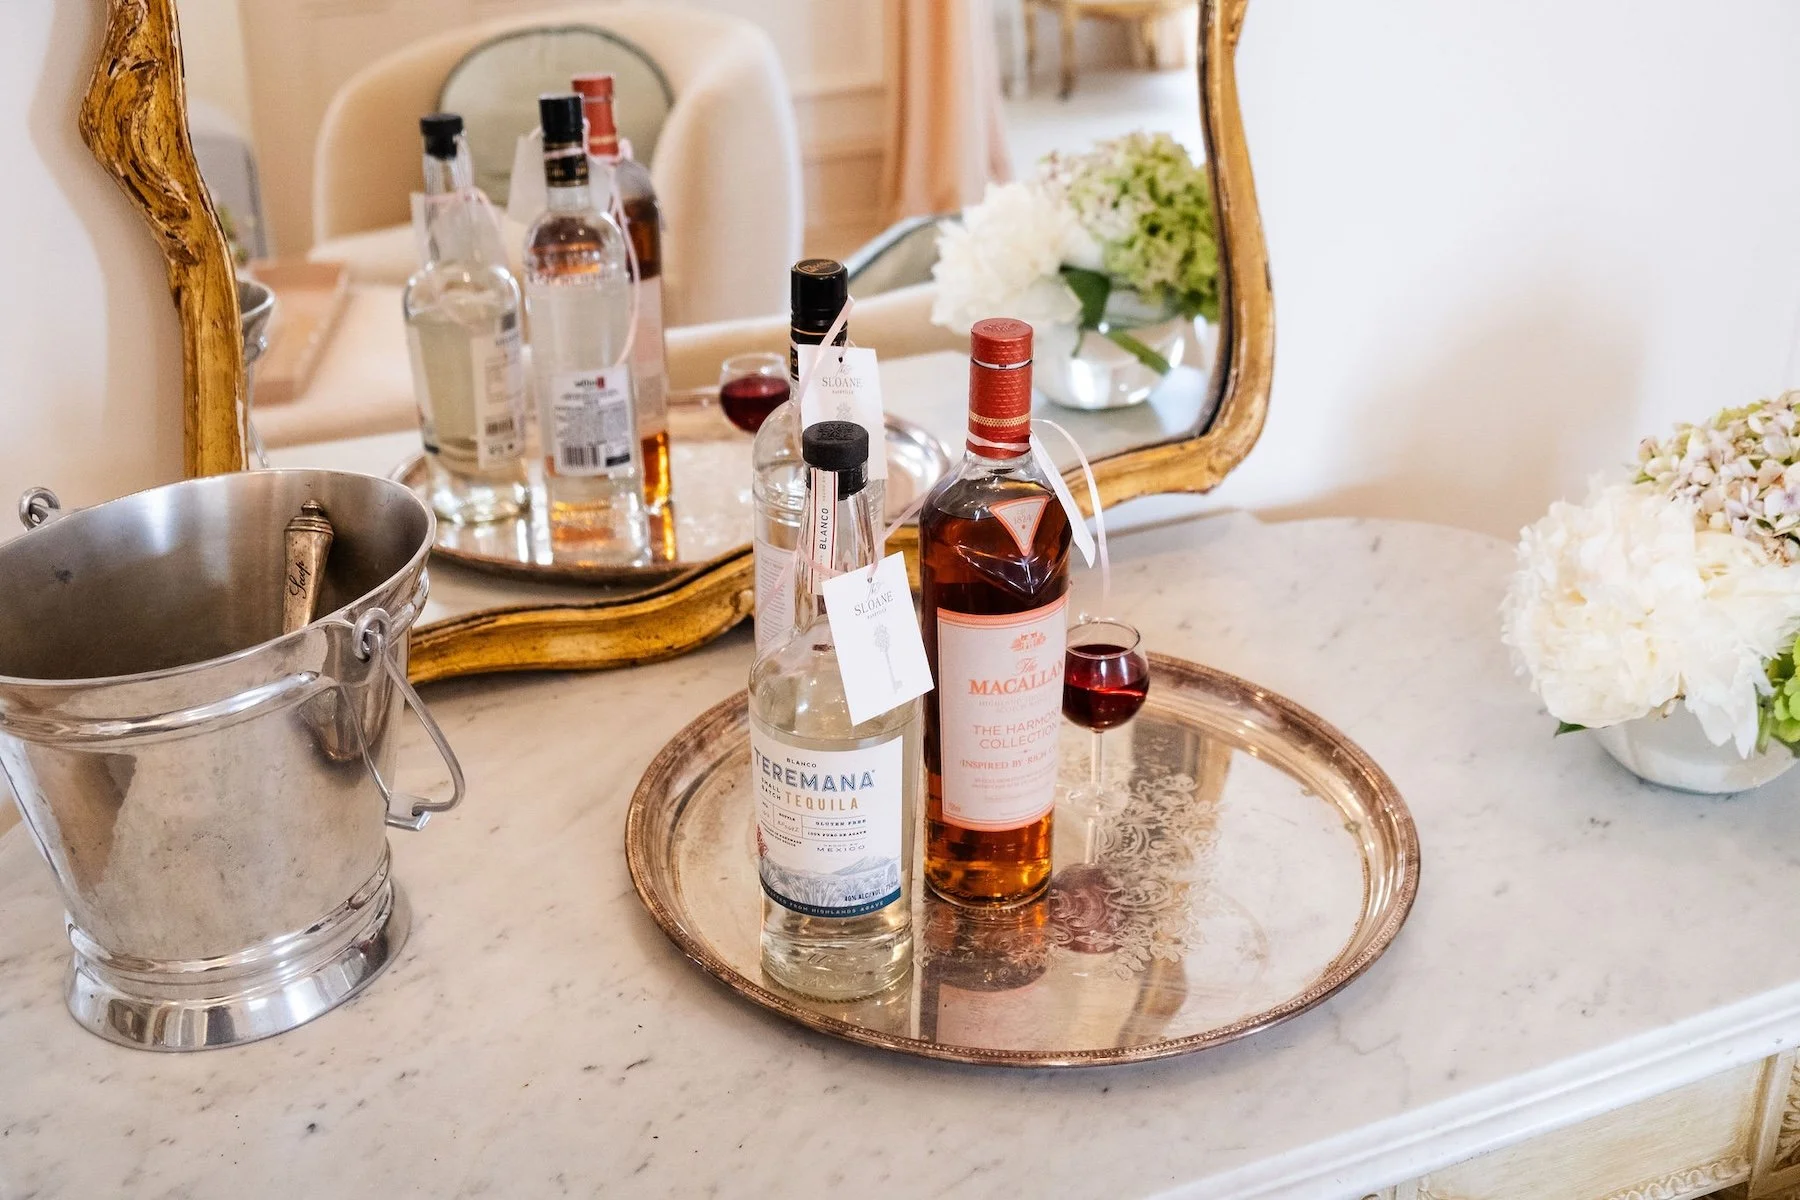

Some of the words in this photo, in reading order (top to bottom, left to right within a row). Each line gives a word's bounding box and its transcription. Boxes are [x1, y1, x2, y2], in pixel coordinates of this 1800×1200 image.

[822, 376, 863, 388] SLOANE
[819, 508, 829, 550] BLANCO
[854, 591, 894, 616] SLOANE
[1016, 657, 1038, 675] The
[967, 659, 1064, 696] MACALLAN
[973, 725, 1001, 736] THE
[980, 722, 1057, 750] COLLECTION
[754, 746, 875, 792] TEREMANA
[786, 757, 817, 769] BLANCO
[961, 760, 1009, 770] INSPIRED
[1012, 759, 1022, 768] BY
[785, 791, 858, 811] TEQUILA
[816, 844, 865, 853] MEXICO
[789, 902, 808, 912] FROM
[861, 901, 884, 912] AGAVE
